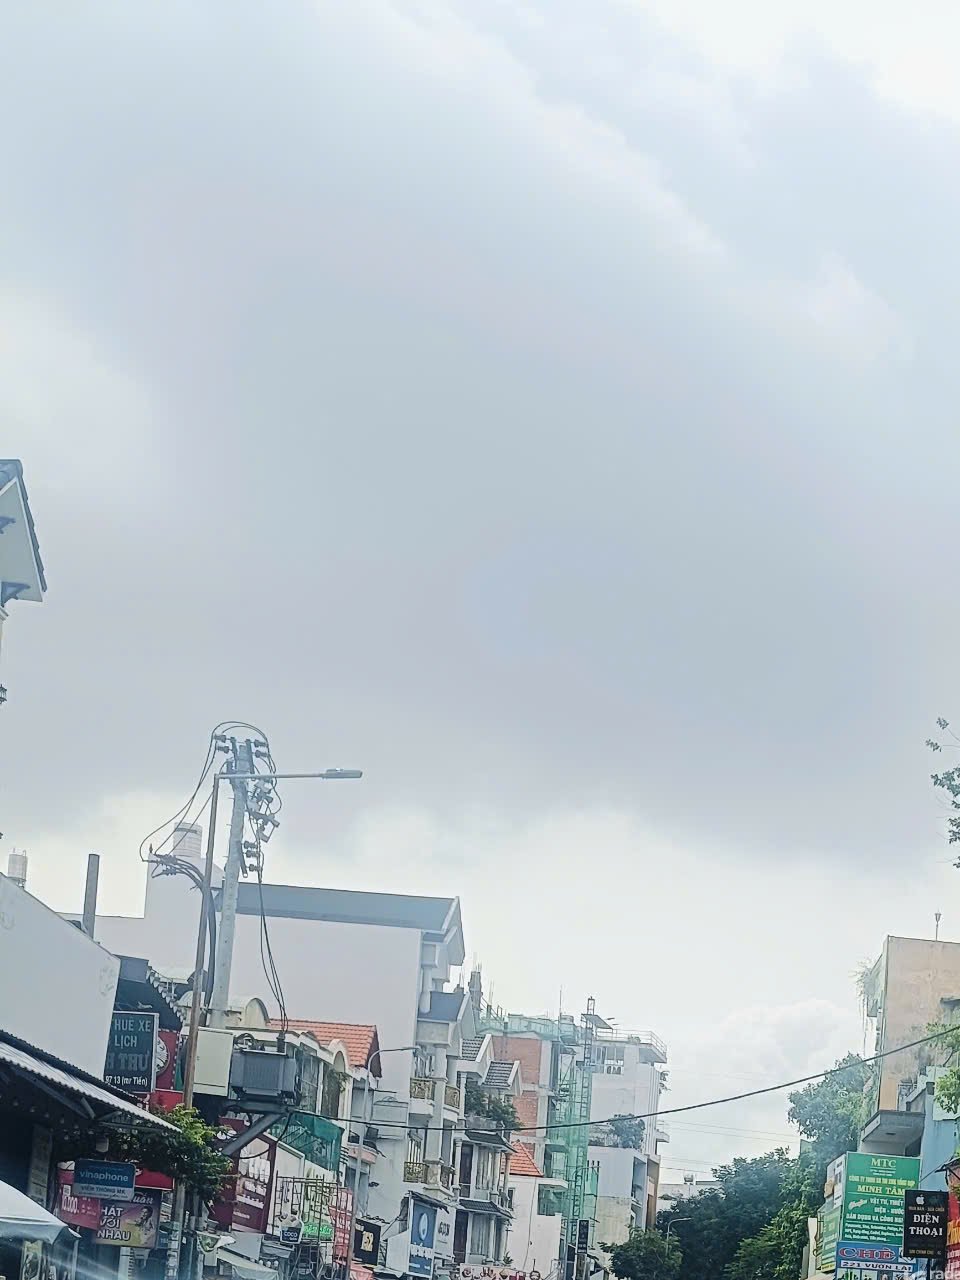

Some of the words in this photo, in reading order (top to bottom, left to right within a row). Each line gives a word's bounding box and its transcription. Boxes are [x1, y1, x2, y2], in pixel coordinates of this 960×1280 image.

[138, 1020, 151, 1032] XE
[114, 1035, 137, 1049] LỊCH
[114, 1076, 120, 1084] 13
[871, 1158, 896, 1168] MTC
[80, 1170, 129, 1182] vinaphone
[857, 1185, 882, 1194] MINH
[913, 1212, 940, 1225] ĐIỆN
[97, 1229, 132, 1241] NHAU
[909, 1226, 943, 1238] THOẠI
[839, 1247, 896, 1261] CHÈ
